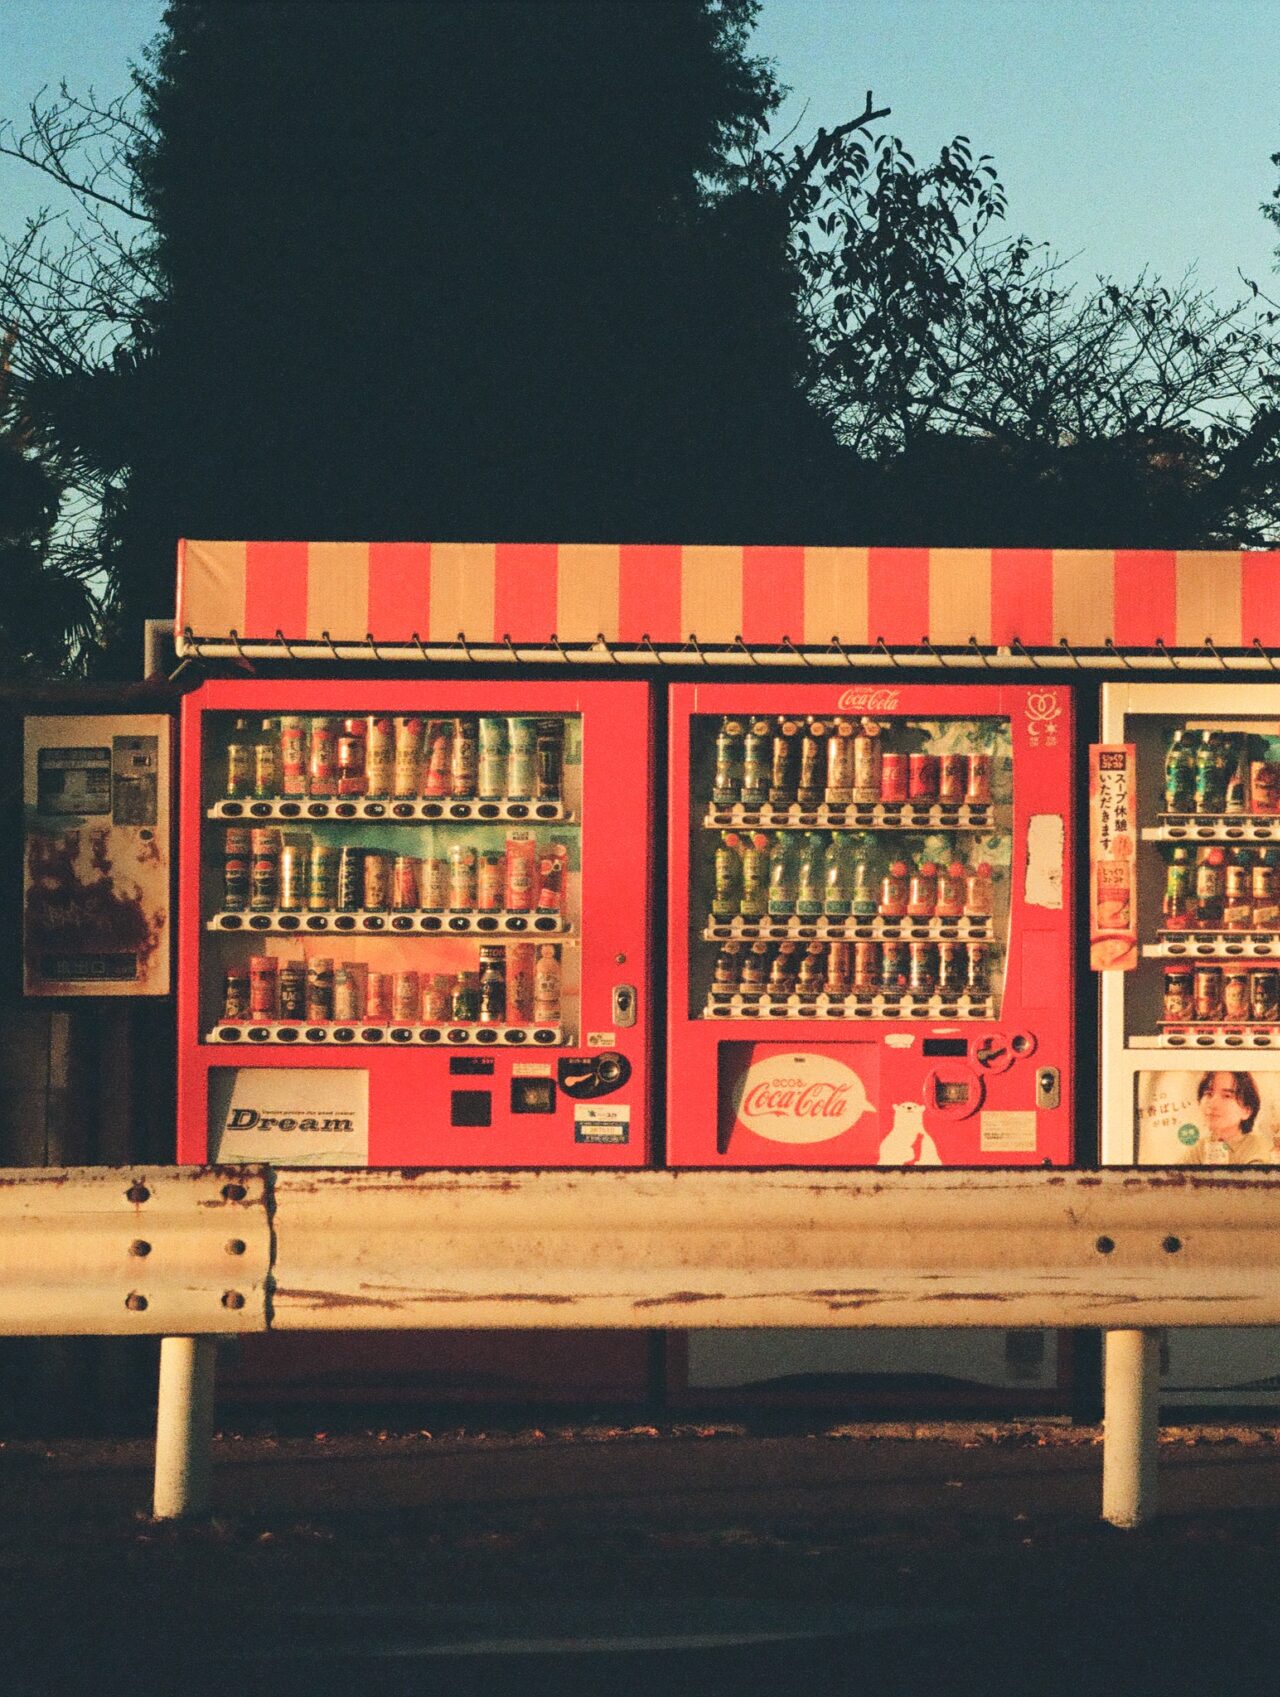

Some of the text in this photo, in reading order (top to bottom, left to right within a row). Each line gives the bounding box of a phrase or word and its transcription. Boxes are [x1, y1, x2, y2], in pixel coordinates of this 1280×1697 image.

[838, 689, 901, 711] Coca-Cola
[1100, 774, 1112, 854] いただきます。
[1114, 774, 1128, 832] スープ休憩
[743, 1082, 853, 1117] Coca-Cola
[227, 1108, 354, 1132] Dream
